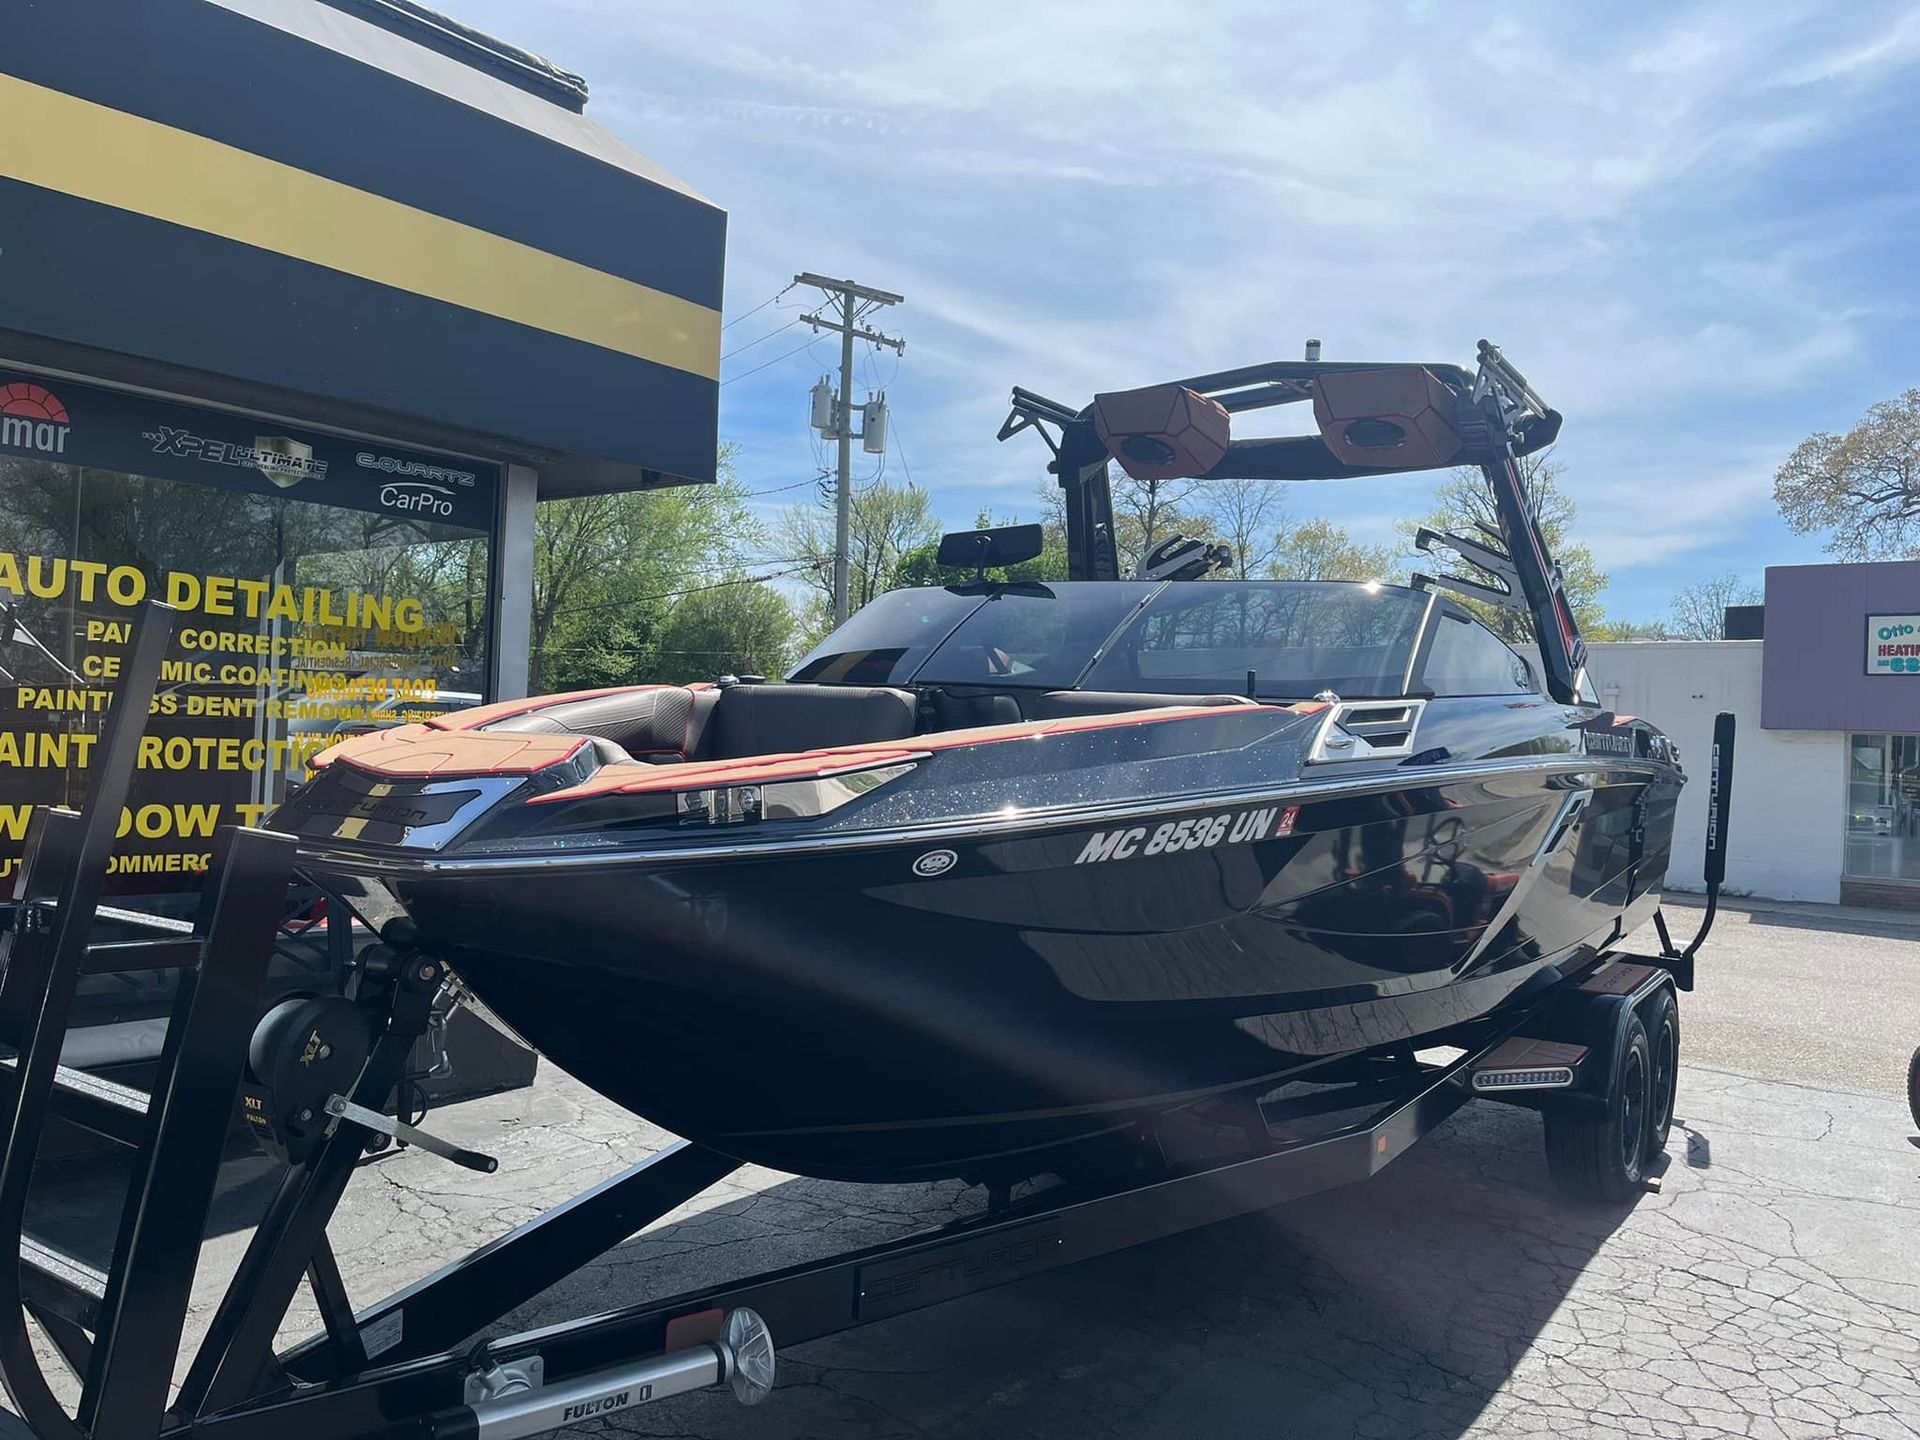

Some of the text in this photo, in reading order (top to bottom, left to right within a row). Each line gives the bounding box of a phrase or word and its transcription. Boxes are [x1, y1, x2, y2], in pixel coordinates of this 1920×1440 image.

[152, 426, 328, 473] XPEL ULTIMATE
[380, 487, 453, 516] CarPro
[0, 552, 423, 633] AUTO DETAILING
[180, 629, 346, 658] CORRECTION
[1878, 624, 1914, 641] Otto
[82, 655, 346, 690] CEMIC COATINGS
[187, 695, 257, 718] DENT
[1708, 743, 1720, 850] CENTURION
[1279, 812, 1294, 828] 24
[1075, 807, 1278, 865] MC 8536 UN
[244, 1096, 263, 1111] XLT
[563, 1391, 630, 1422] FULTON
